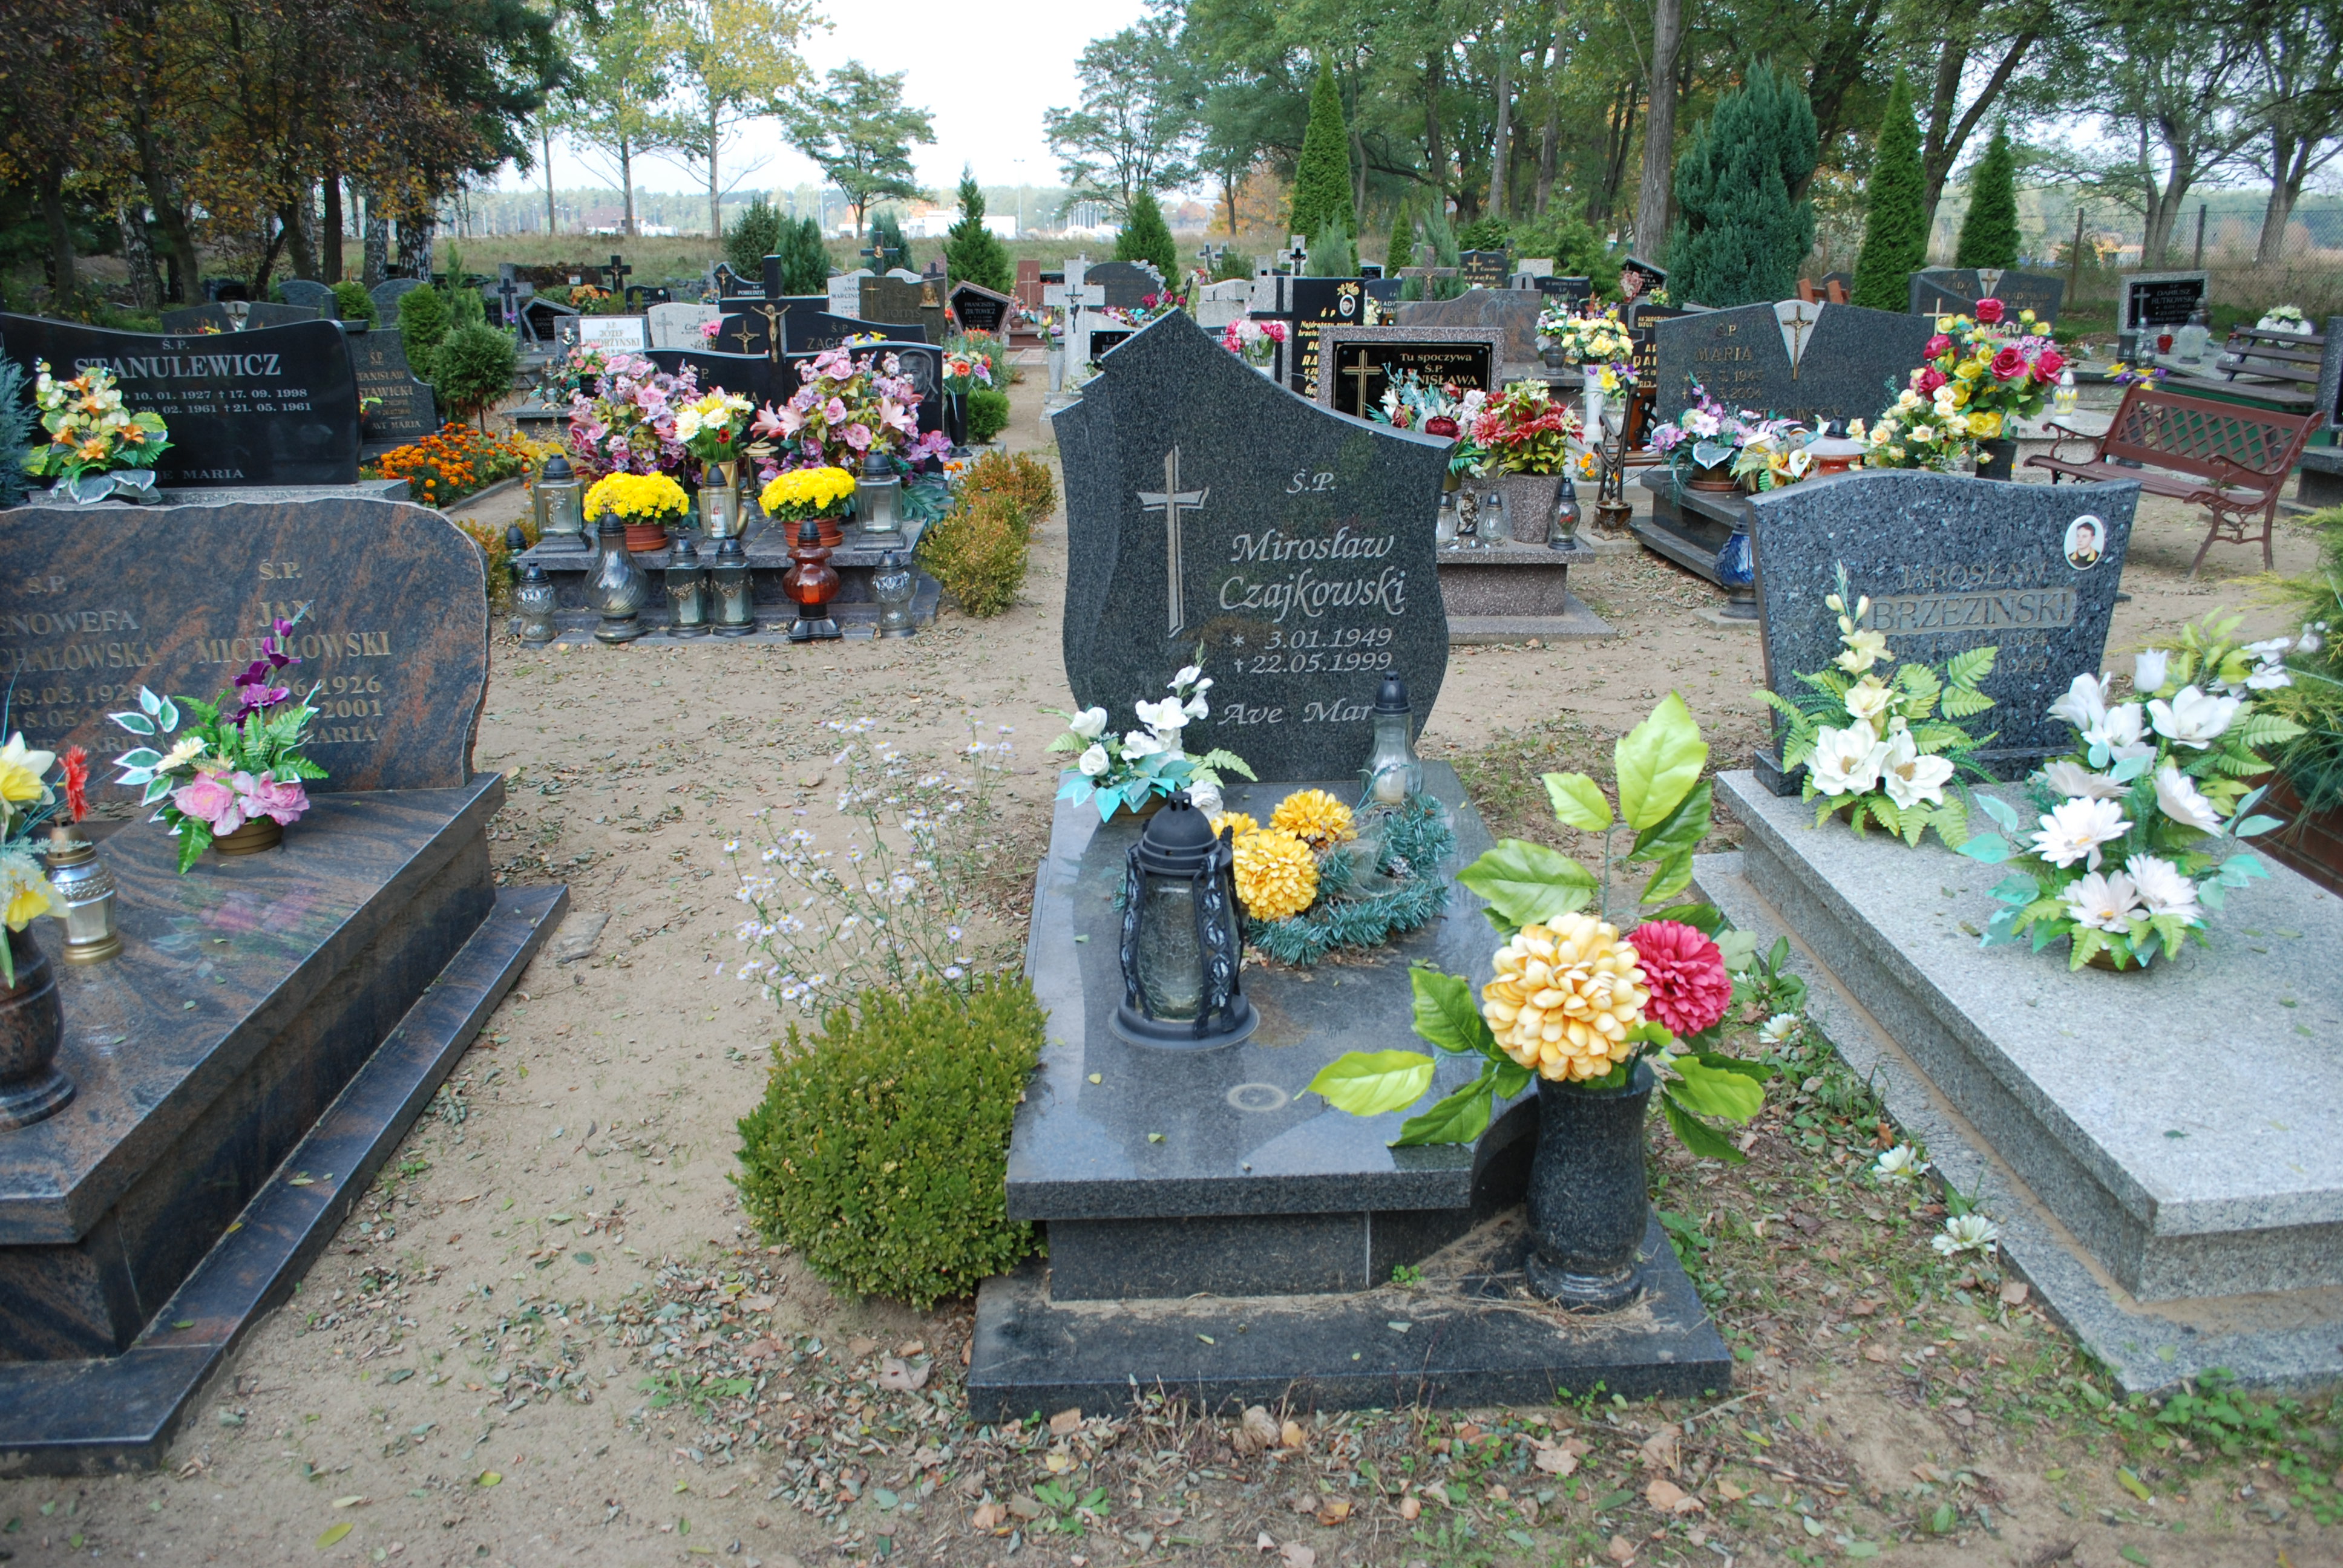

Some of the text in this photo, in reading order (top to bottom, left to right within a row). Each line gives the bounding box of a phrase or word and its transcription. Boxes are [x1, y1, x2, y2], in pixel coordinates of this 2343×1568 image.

[74, 354, 282, 379] STANULEWICZ
[1400, 353, 1473, 363] Tu spoczywa
[1695, 347, 1753, 362] MARIA
[181, 390, 212, 400] 1927
[252, 389, 272, 399] 09.
[276, 388, 307, 399] 1998
[188, 403, 217, 414] 1961
[257, 403, 277, 413] 05.
[281, 402, 312, 412] 1961
[183, 469, 245, 480] MARIA
[1230, 526, 1394, 563] Mirosław
[1897, 561, 2048, 590] JAROSŁAW
[1219, 566, 1407, 624] Czajkowski
[258, 599, 316, 627] JAN
[1870, 591, 2069, 631] BRZEZIŃSKI
[195, 630, 392, 665] MICHŁOWSKI
[1264, 627, 1393, 651] 3.01.1949
[1248, 651, 1393, 675] 22.05.1999
[1217, 698, 1374, 725] Ave Mar
